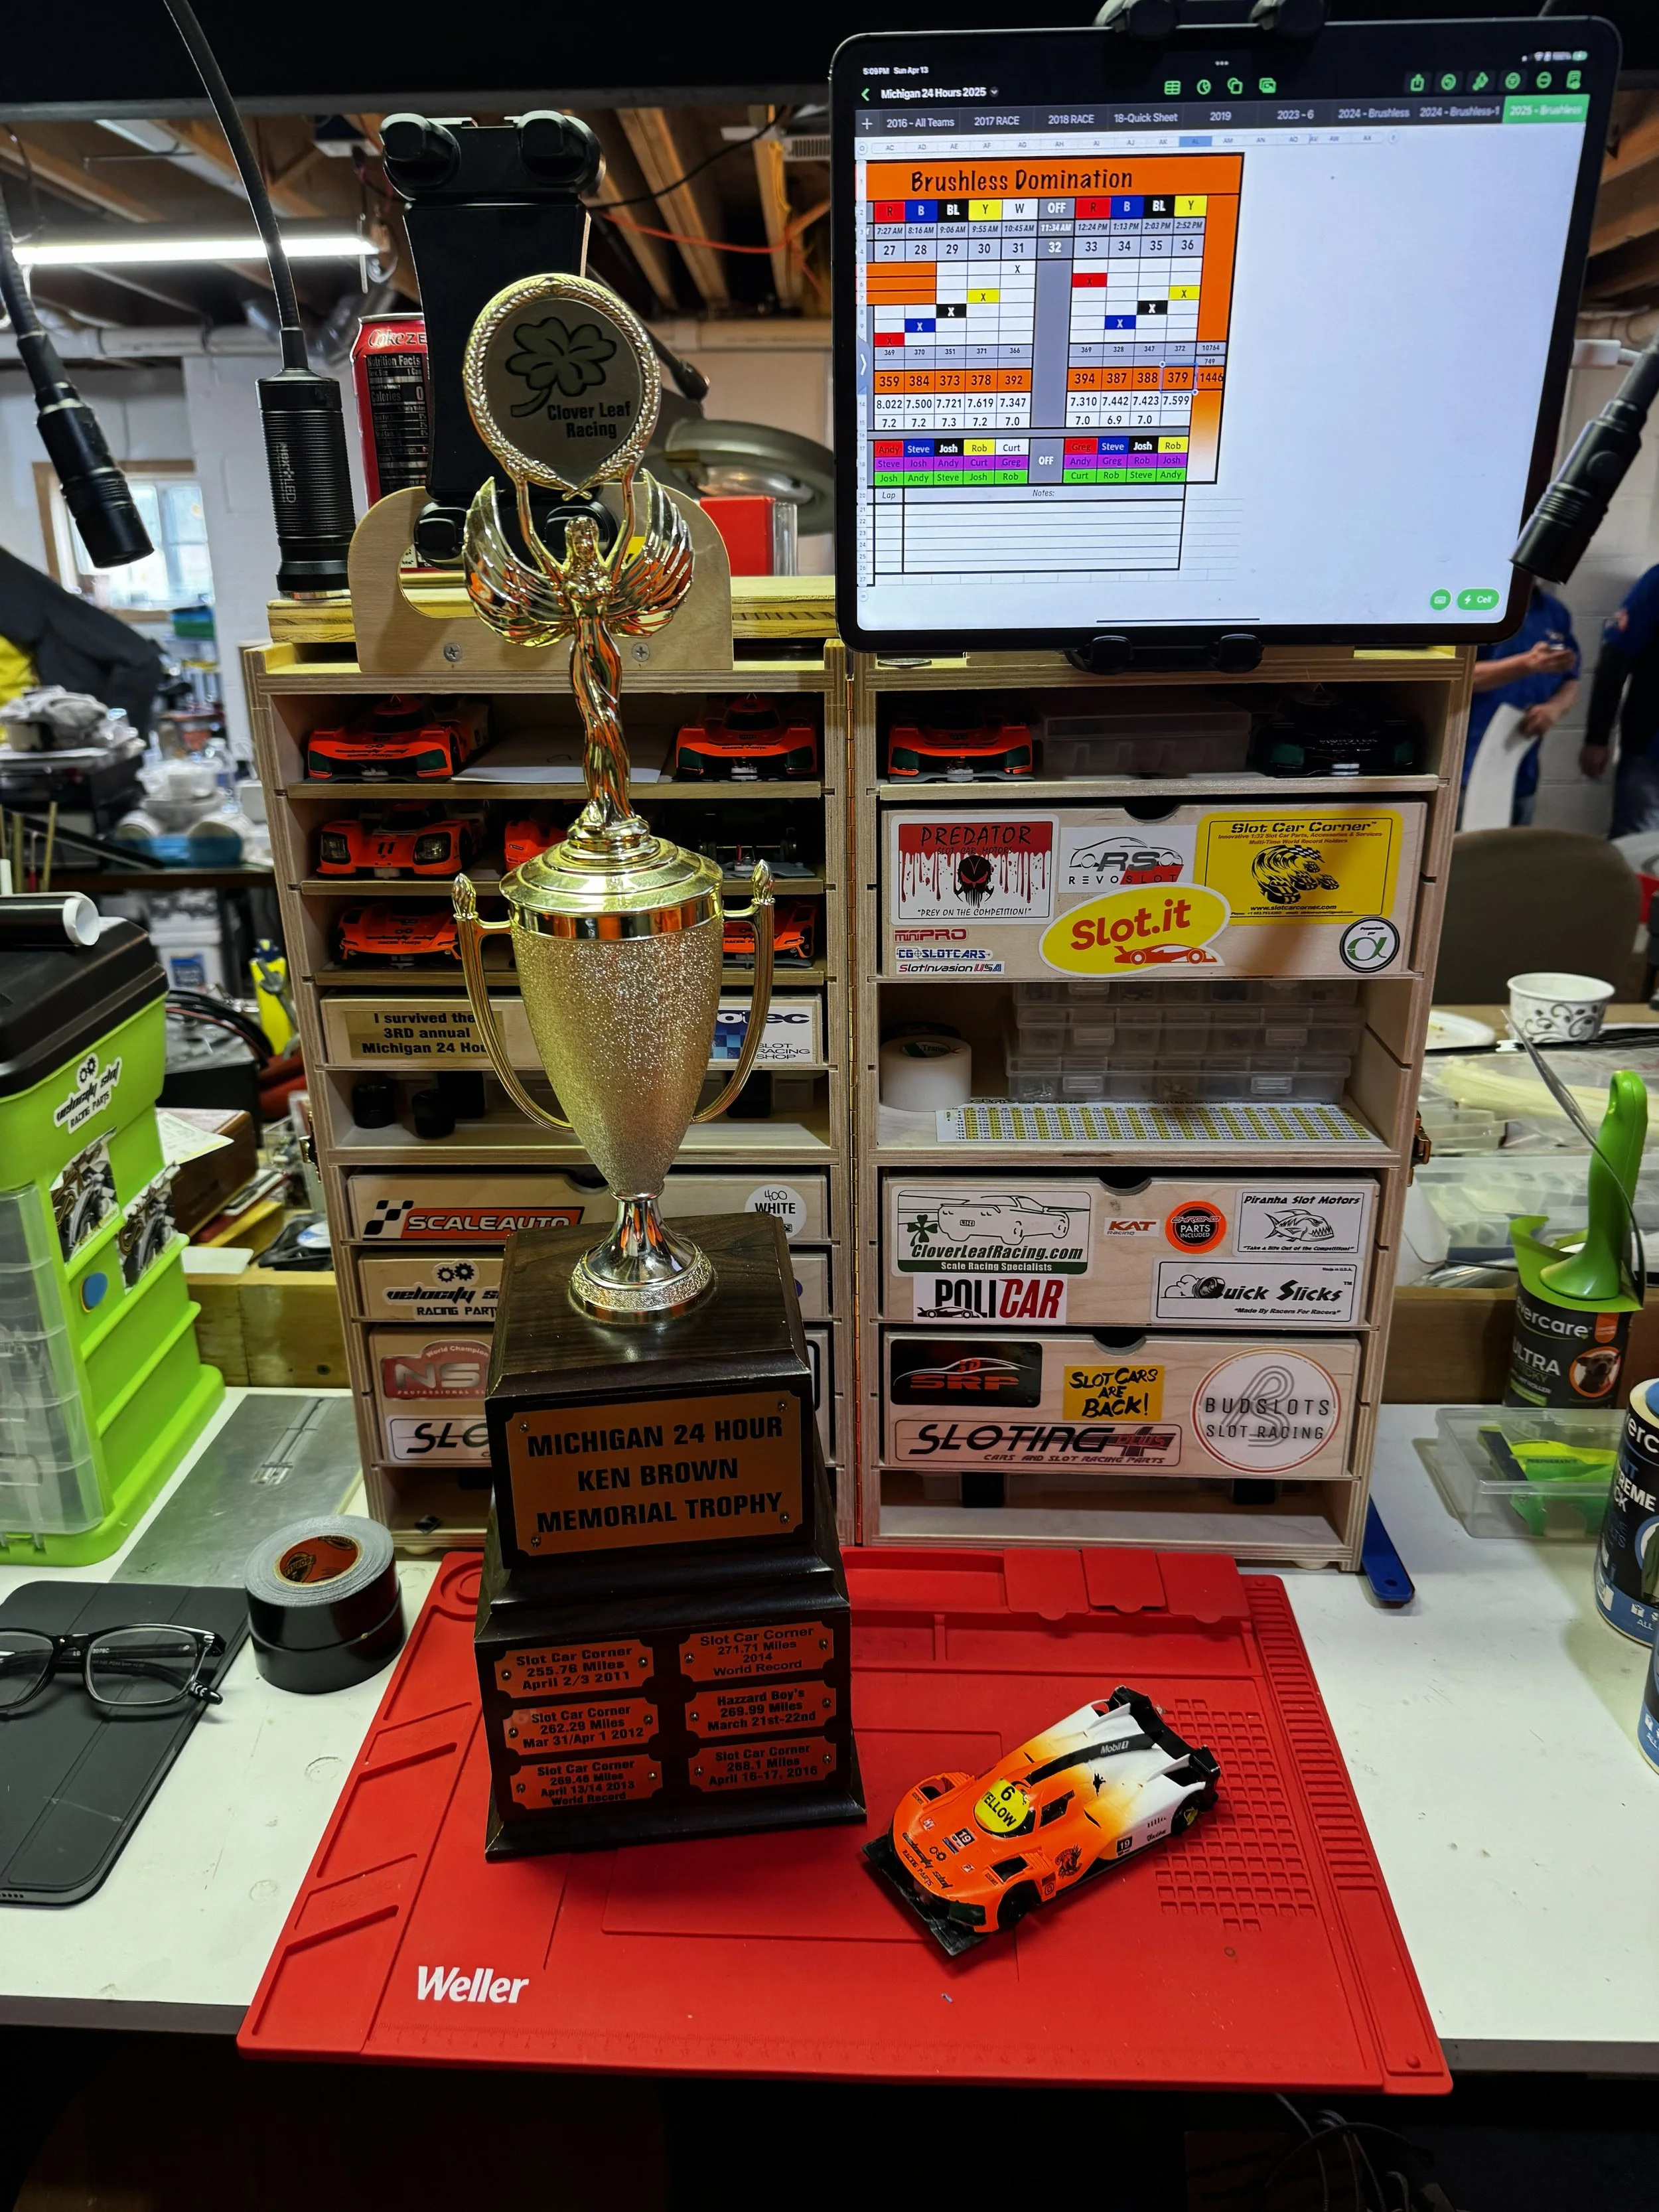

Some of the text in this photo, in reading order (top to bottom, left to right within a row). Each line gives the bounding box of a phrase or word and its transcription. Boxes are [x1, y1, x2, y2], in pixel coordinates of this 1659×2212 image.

[881, 88, 986, 100] Michigan 24 Hours 2025
[974, 116, 1019, 126] 2017 RACE
[1048, 114, 1094, 124] 2018 RACE
[1114, 112, 1177, 123] 18-Quick Sheet
[1210, 111, 1231, 121] 2019
[911, 169, 1132, 192] Brushless Domination
[399, 355, 421, 365] Facts
[880, 372, 1188, 386] 359 384 373 378 392 394 387 388 379
[877, 396, 1189, 409] 8.022 7.500 7.721 7.619 7.347 7.310 7.442 7.423 7.599
[547, 401, 630, 420] Clover Leaf
[566, 421, 616, 439] Racing
[879, 445, 899, 455] Andy
[907, 445, 930, 453] Steve
[939, 444, 958, 453] Josh
[1003, 443, 1020, 452] Curt
[1072, 443, 1090, 453] Greg
[1102, 442, 1124, 451] Steve
[1133, 442, 1152, 451] Josh
[1231, 824, 1267, 833] Slot
[1272, 822, 1304, 832] Car
[921, 826, 1031, 846] PREDATOR
[1096, 851, 1160, 871] RS
[1069, 875, 1177, 884] REVOSLOT
[1070, 899, 1191, 950] Slot.it
[922, 950, 985, 959] SLOTCARS
[974, 964, 1001, 972] USA
[374, 1013, 475, 1023] I survived the
[384, 1028, 470, 1038] 3RD annual
[362, 1043, 431, 1055] Michigan
[437, 1043, 455, 1053] 24
[764, 1190, 787, 1201] 400
[755, 1203, 796, 1214] WHITE
[408, 1215, 571, 1232] SCALEAUTO
[1109, 1221, 1157, 1230] KAT
[912, 1244, 1083, 1260] CloverLeafRacing.com
[968, 1262, 998, 1271] Racing
[1001, 1263, 1052, 1272] Specialists
[1276, 1280, 1343, 1302] Slicks
[466, 1307, 496, 1317] PART
[1512, 1337, 1561, 1376] ULTRA
[910, 1376, 1019, 1390] SRP
[1069, 1368, 1157, 1388] SLOT CARS
[1098, 1386, 1127, 1398] ARE
[1081, 1393, 1149, 1418] BACK!
[1205, 1397, 1330, 1416] BUDSLOTS
[528, 1416, 782, 1457] MICHIGAN 24 HOUR
[1206, 1424, 1324, 1439] SLOT RACING
[908, 1424, 1115, 1455] SLOTING
[578, 1458, 738, 1491] KEN BROWN
[537, 1492, 782, 1533] MEMORIAL TROPHY
[701, 1628, 814, 1646] Slot Car Corner
[718, 1641, 796, 1655] 271.71 Miles
[516, 1647, 632, 1666] Slot Car Corner
[743, 1653, 772, 1663] 2014
[527, 1660, 624, 1677] 255.76 Miles
[713, 1660, 802, 1676] World Record
[522, 1671, 629, 1690] April 2/3 2011
[717, 1688, 804, 1706] Hazzard Boy's
[721, 1702, 802, 1718] 269.99 Miles
[708, 1712, 816, 1731] March 21st-22nd
[1001, 1786, 1015, 1801] 6
[960, 1832, 972, 1844] 19
[1119, 1840, 1130, 1849] 19
[418, 1966, 530, 2003] Weller
